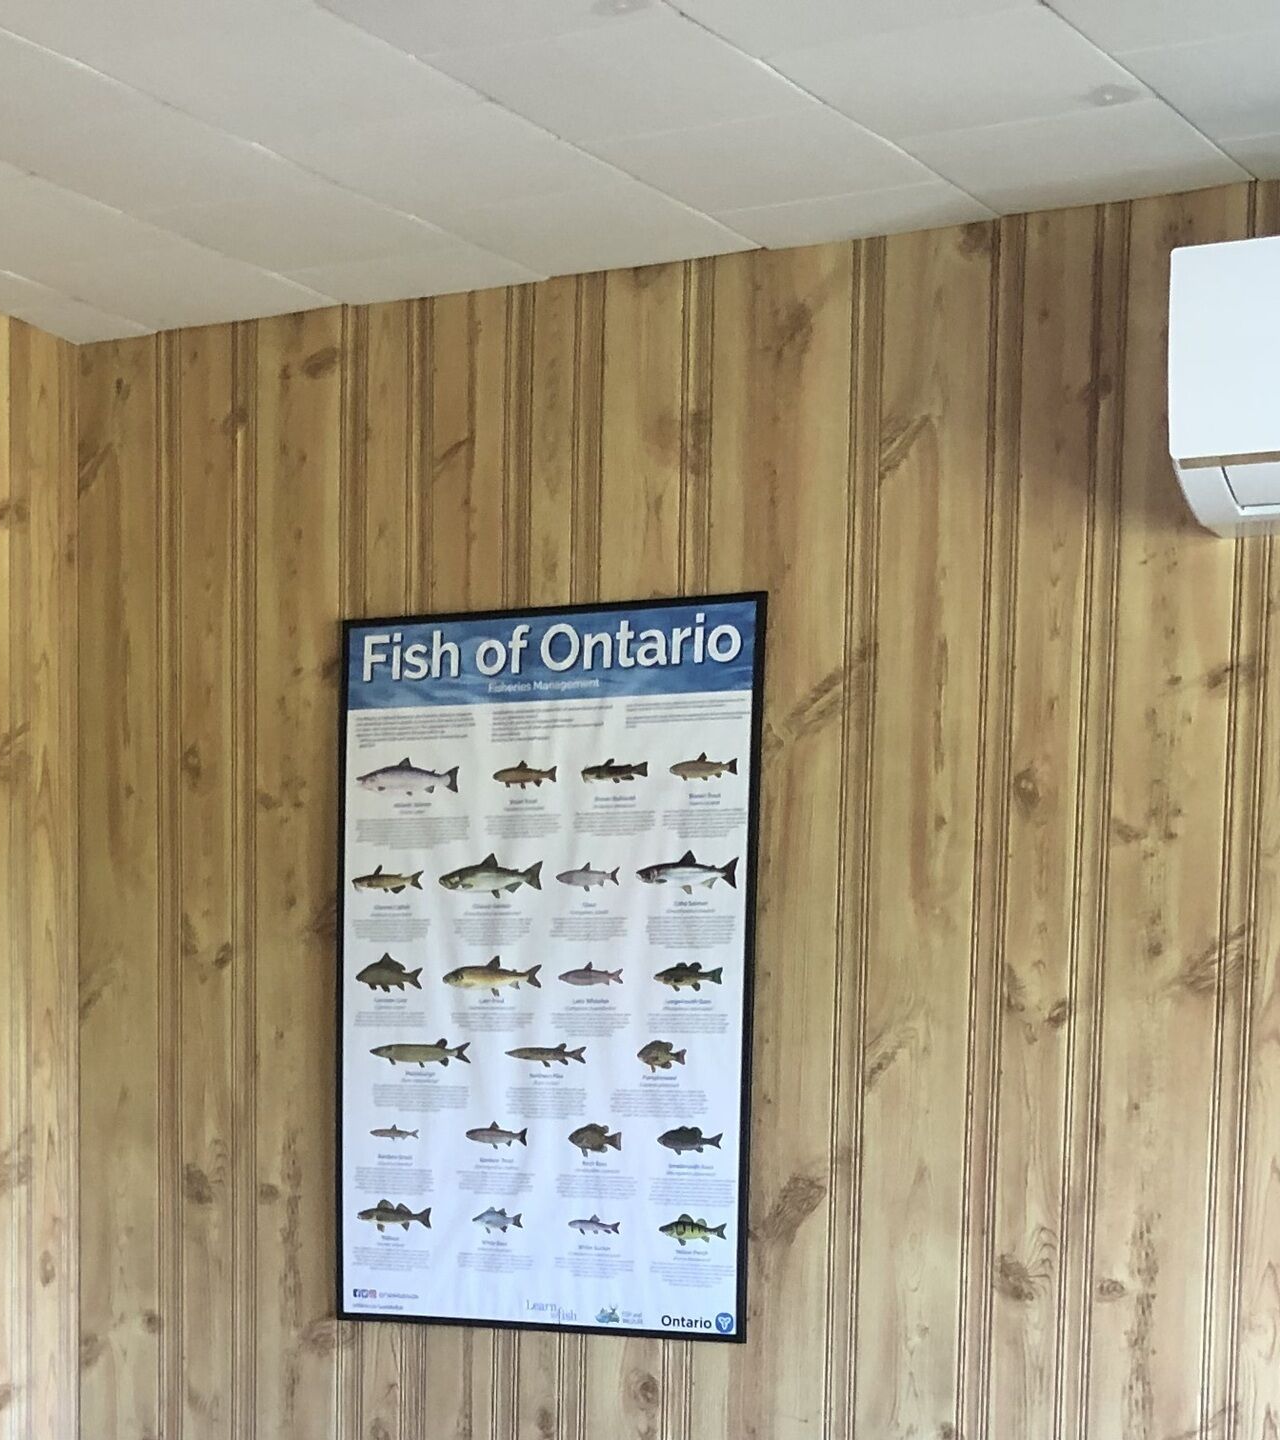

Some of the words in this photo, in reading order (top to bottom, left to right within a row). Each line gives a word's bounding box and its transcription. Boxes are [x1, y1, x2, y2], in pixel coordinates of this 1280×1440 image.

[362, 630, 460, 682] Fish
[475, 625, 530, 677] of
[540, 613, 742, 672] Ontario
[533, 679, 599, 691] Management
[526, 1299, 557, 1312] Learn
[557, 1306, 578, 1325] fish
[661, 1314, 712, 1330] Ontario
